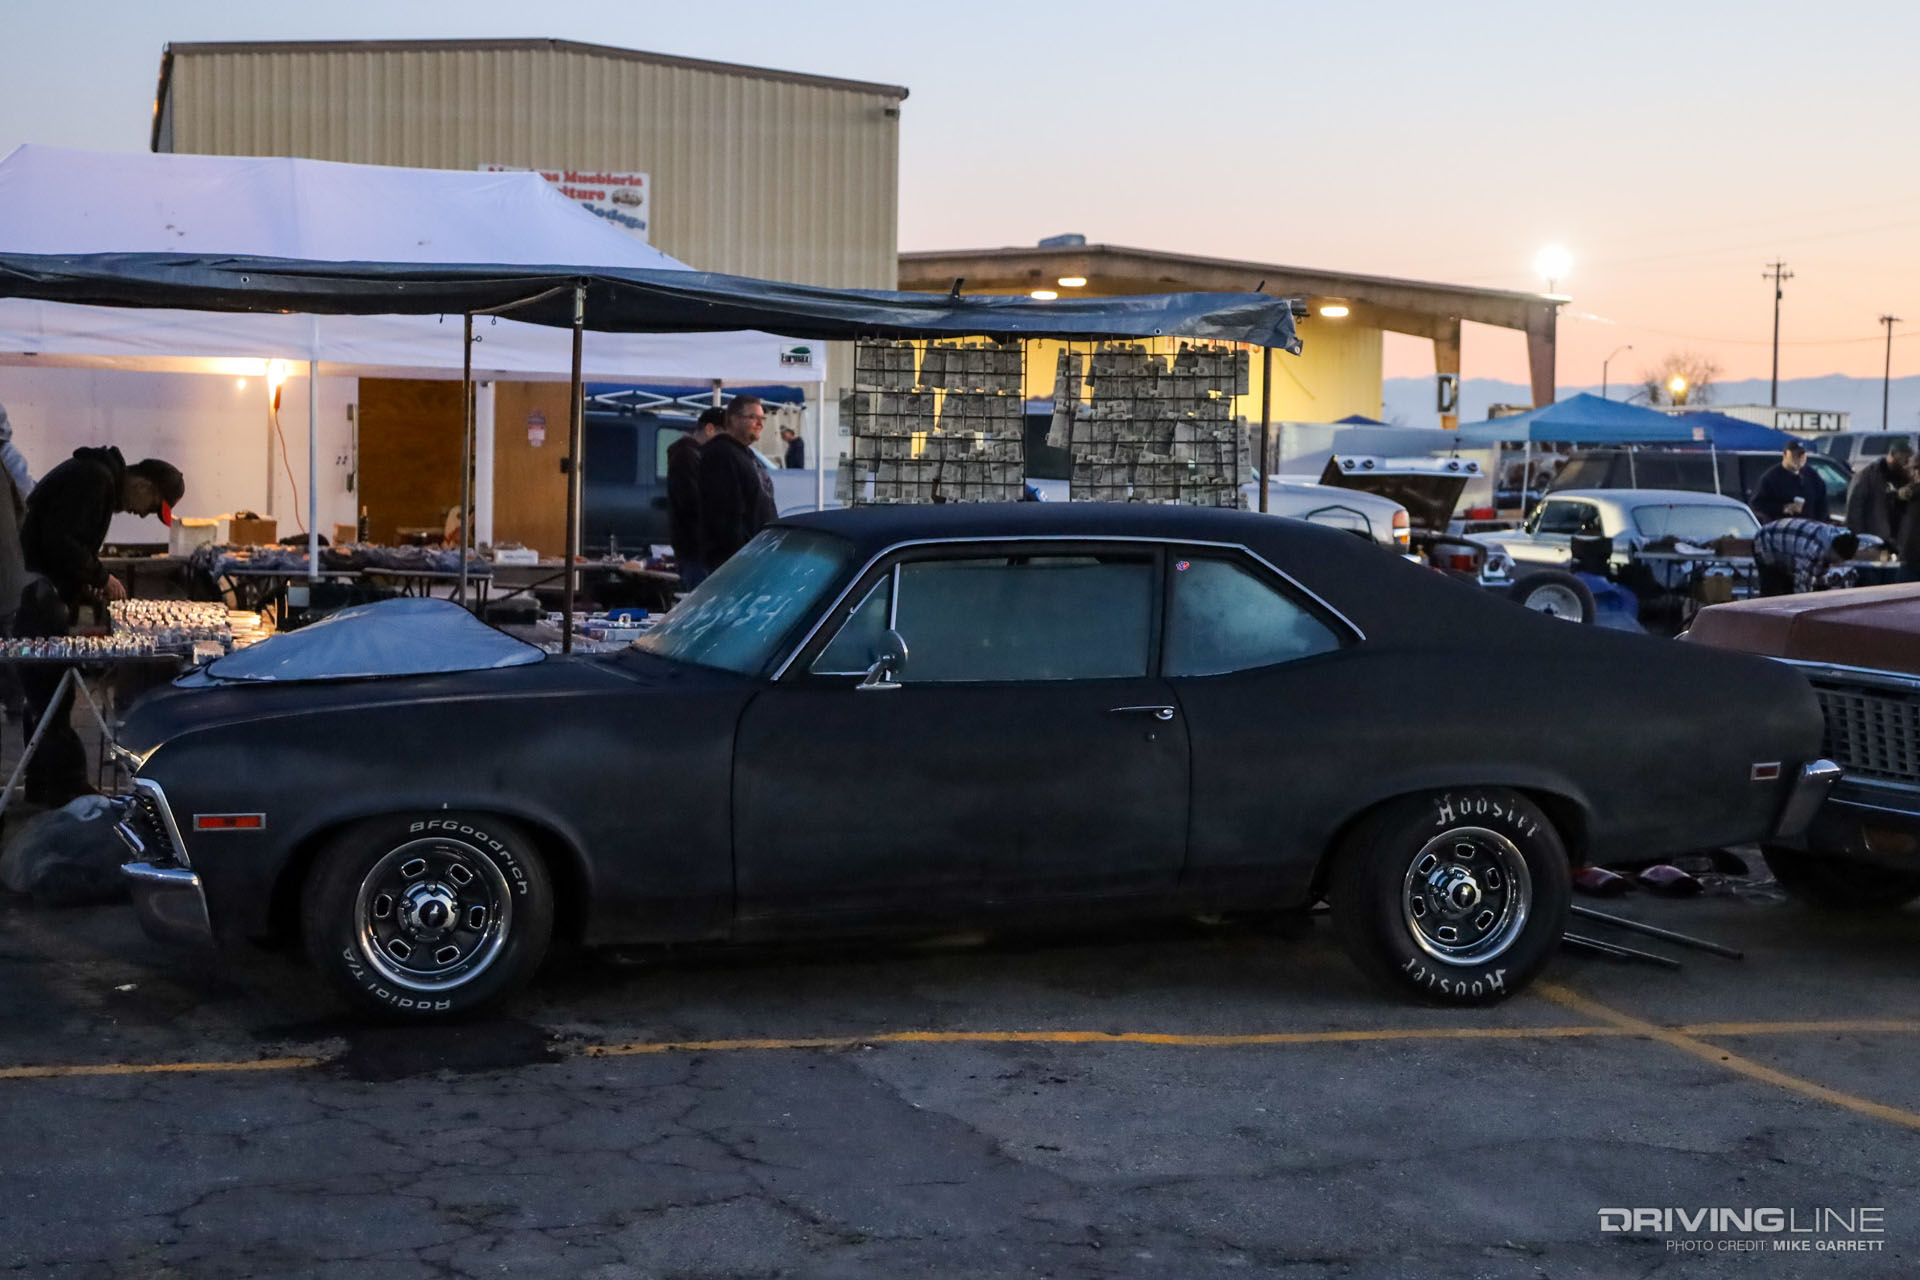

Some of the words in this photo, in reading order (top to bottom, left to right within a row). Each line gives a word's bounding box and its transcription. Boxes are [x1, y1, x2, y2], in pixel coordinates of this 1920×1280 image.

[564, 170, 643, 186] Muebleria
[557, 185, 606, 200] iture
[1438, 376, 1457, 412] D
[1776, 413, 1839, 430] MEN
[410, 820, 528, 895] BFGoodrich
[367, 983, 450, 1010] Radial
